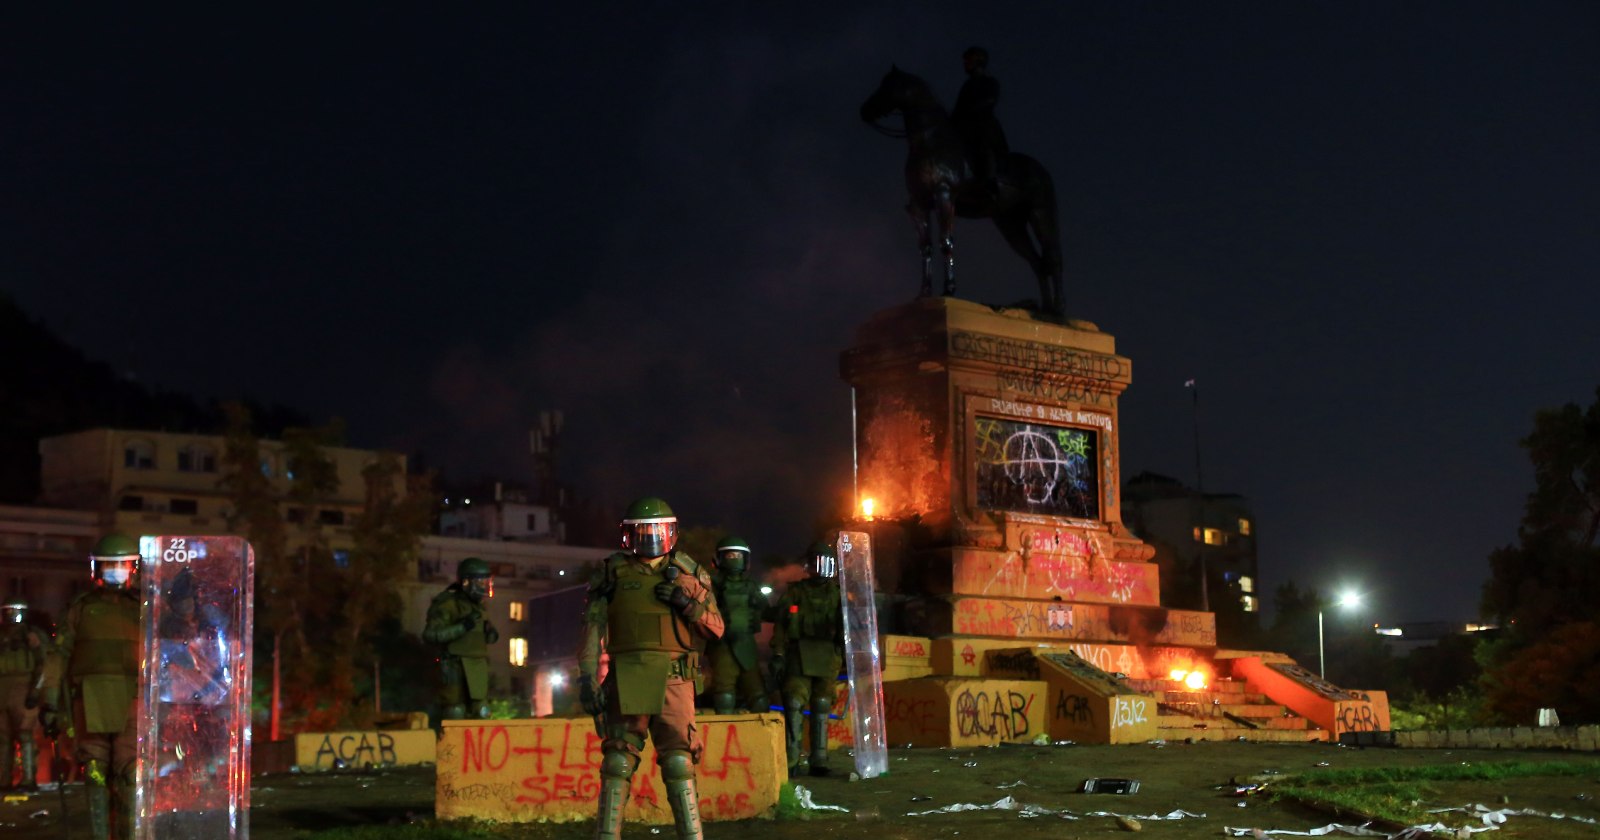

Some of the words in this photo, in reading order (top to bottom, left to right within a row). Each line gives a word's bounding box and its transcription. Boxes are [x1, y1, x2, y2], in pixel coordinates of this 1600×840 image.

[163, 549, 198, 564] COP
[170, 538, 186, 550] 22
[1112, 696, 1147, 729] 1312
[315, 730, 398, 768] ACAB
[462, 725, 511, 774] NO
